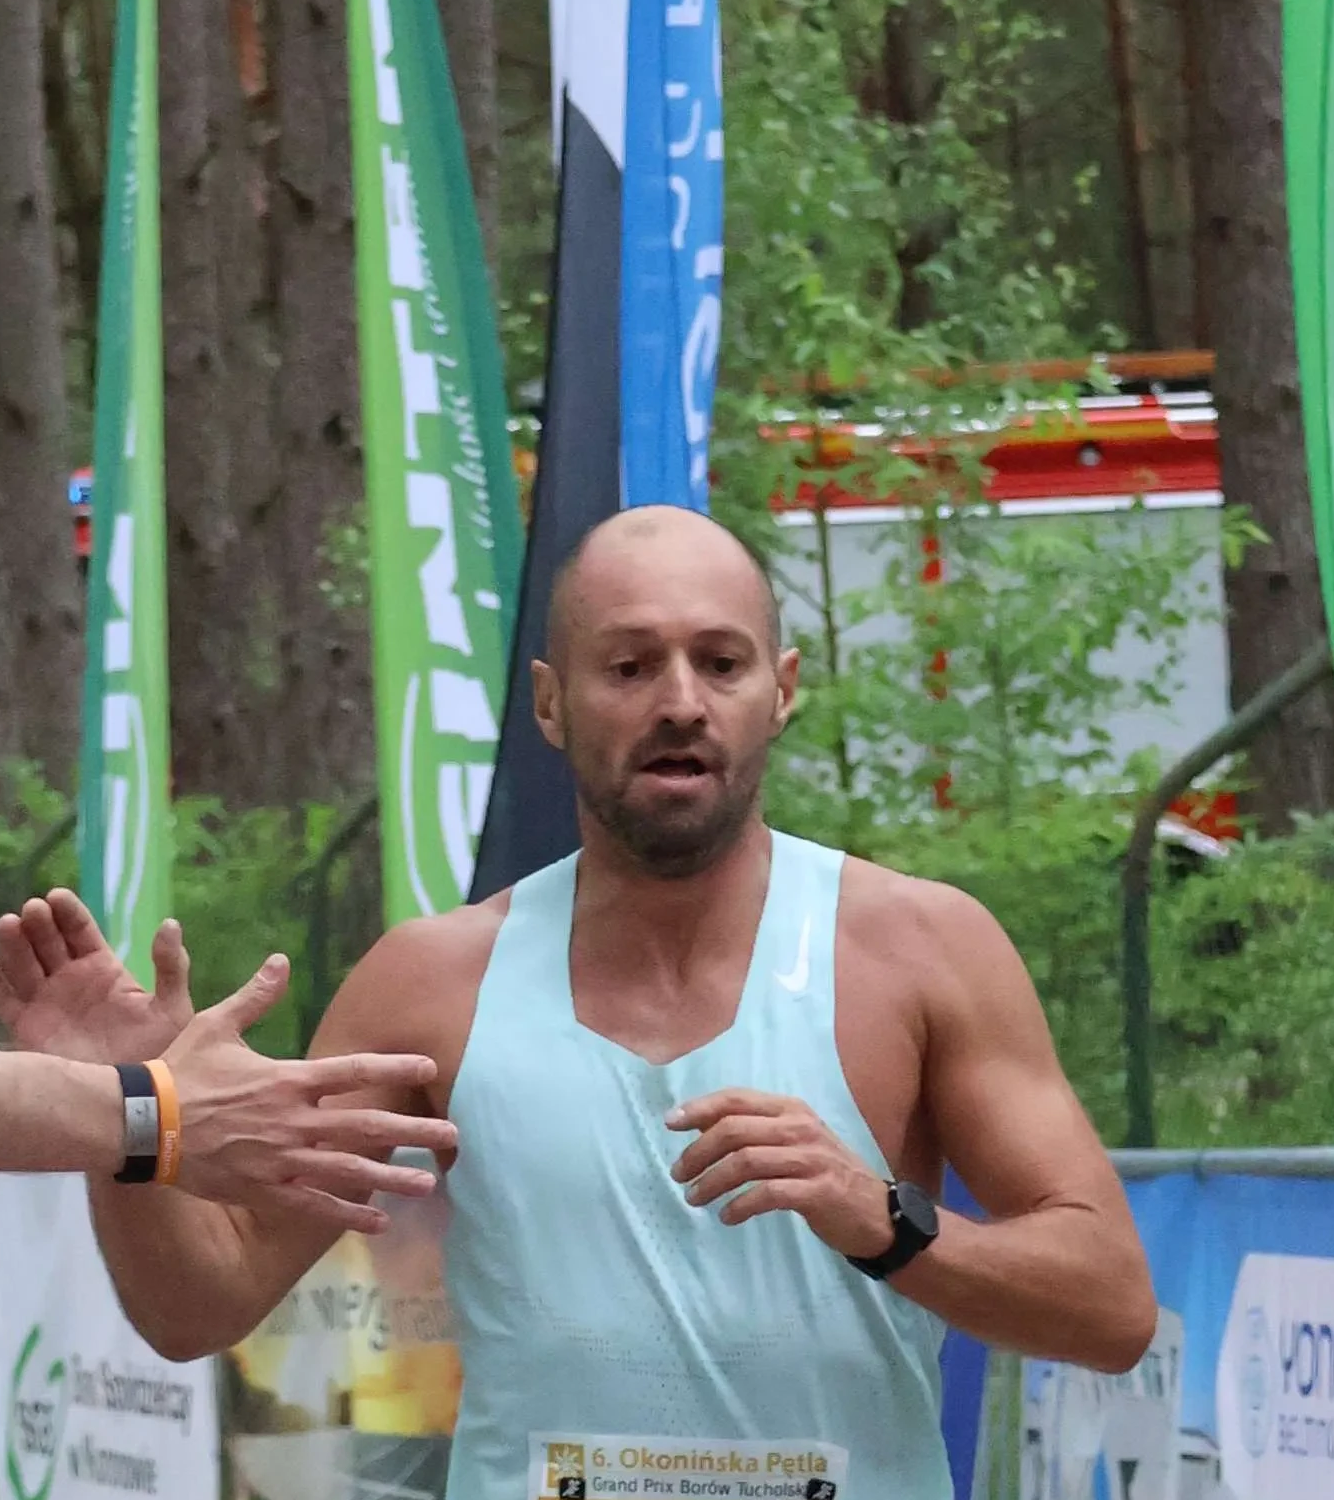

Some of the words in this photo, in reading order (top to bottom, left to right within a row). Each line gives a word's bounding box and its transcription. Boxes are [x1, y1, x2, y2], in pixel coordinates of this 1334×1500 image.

[592, 1449, 613, 1468] 6.
[619, 1447, 759, 1474] Okonińska
[768, 1451, 829, 1479] Pętla
[593, 1476, 638, 1493] Grand
[643, 1477, 673, 1494] Prix
[680, 1479, 731, 1496] Borów
